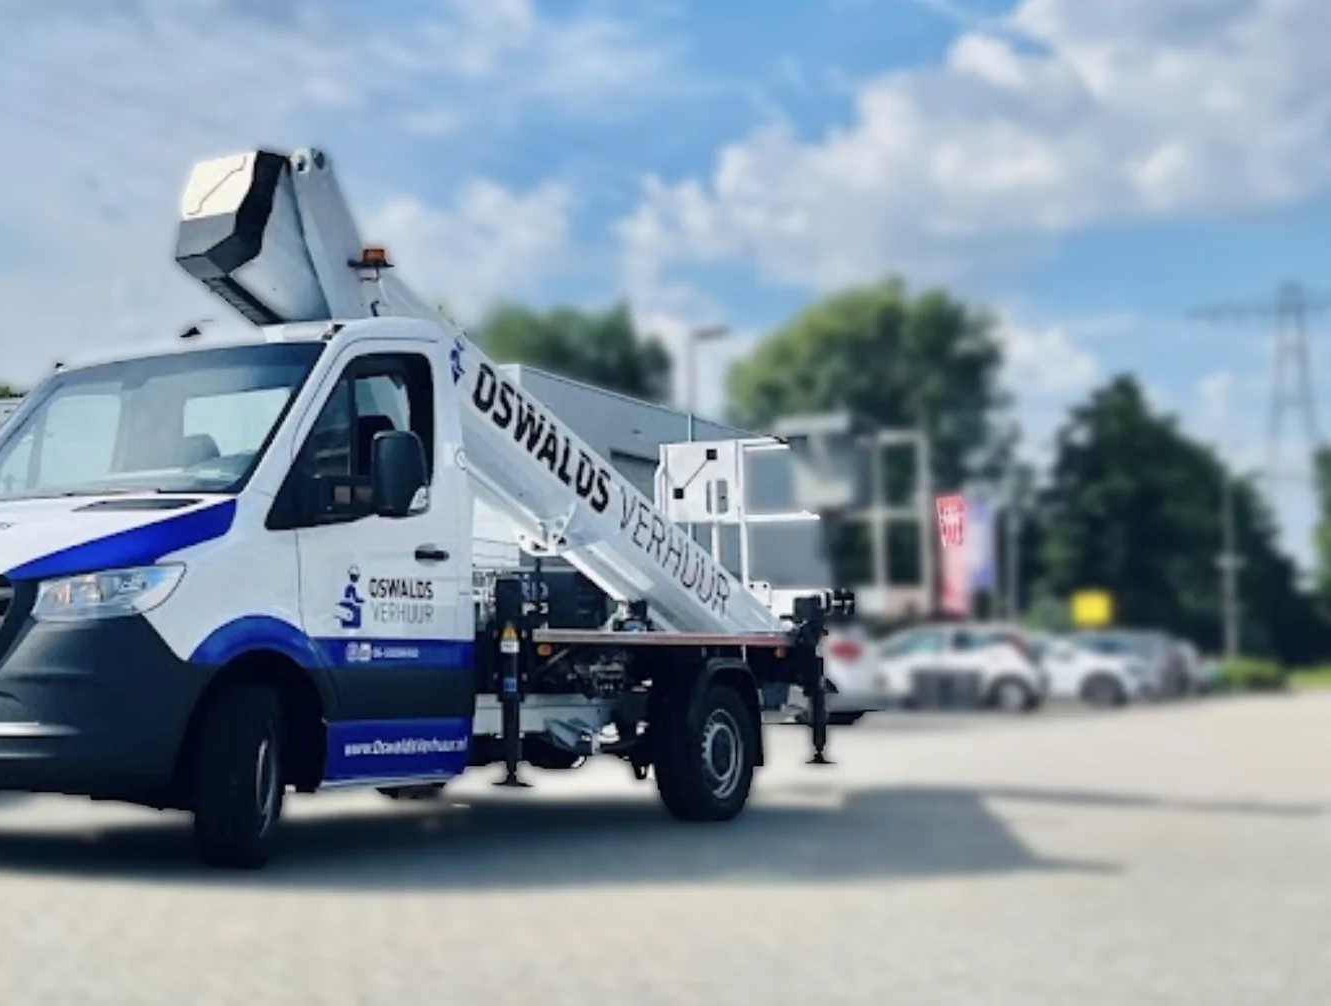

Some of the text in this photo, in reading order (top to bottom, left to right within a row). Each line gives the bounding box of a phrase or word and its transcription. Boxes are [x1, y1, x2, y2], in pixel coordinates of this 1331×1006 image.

[471, 362, 732, 617] OSWALDS VERHUUR
[369, 578, 434, 599] OSWALDS
[371, 602, 434, 624] VERHUUR
